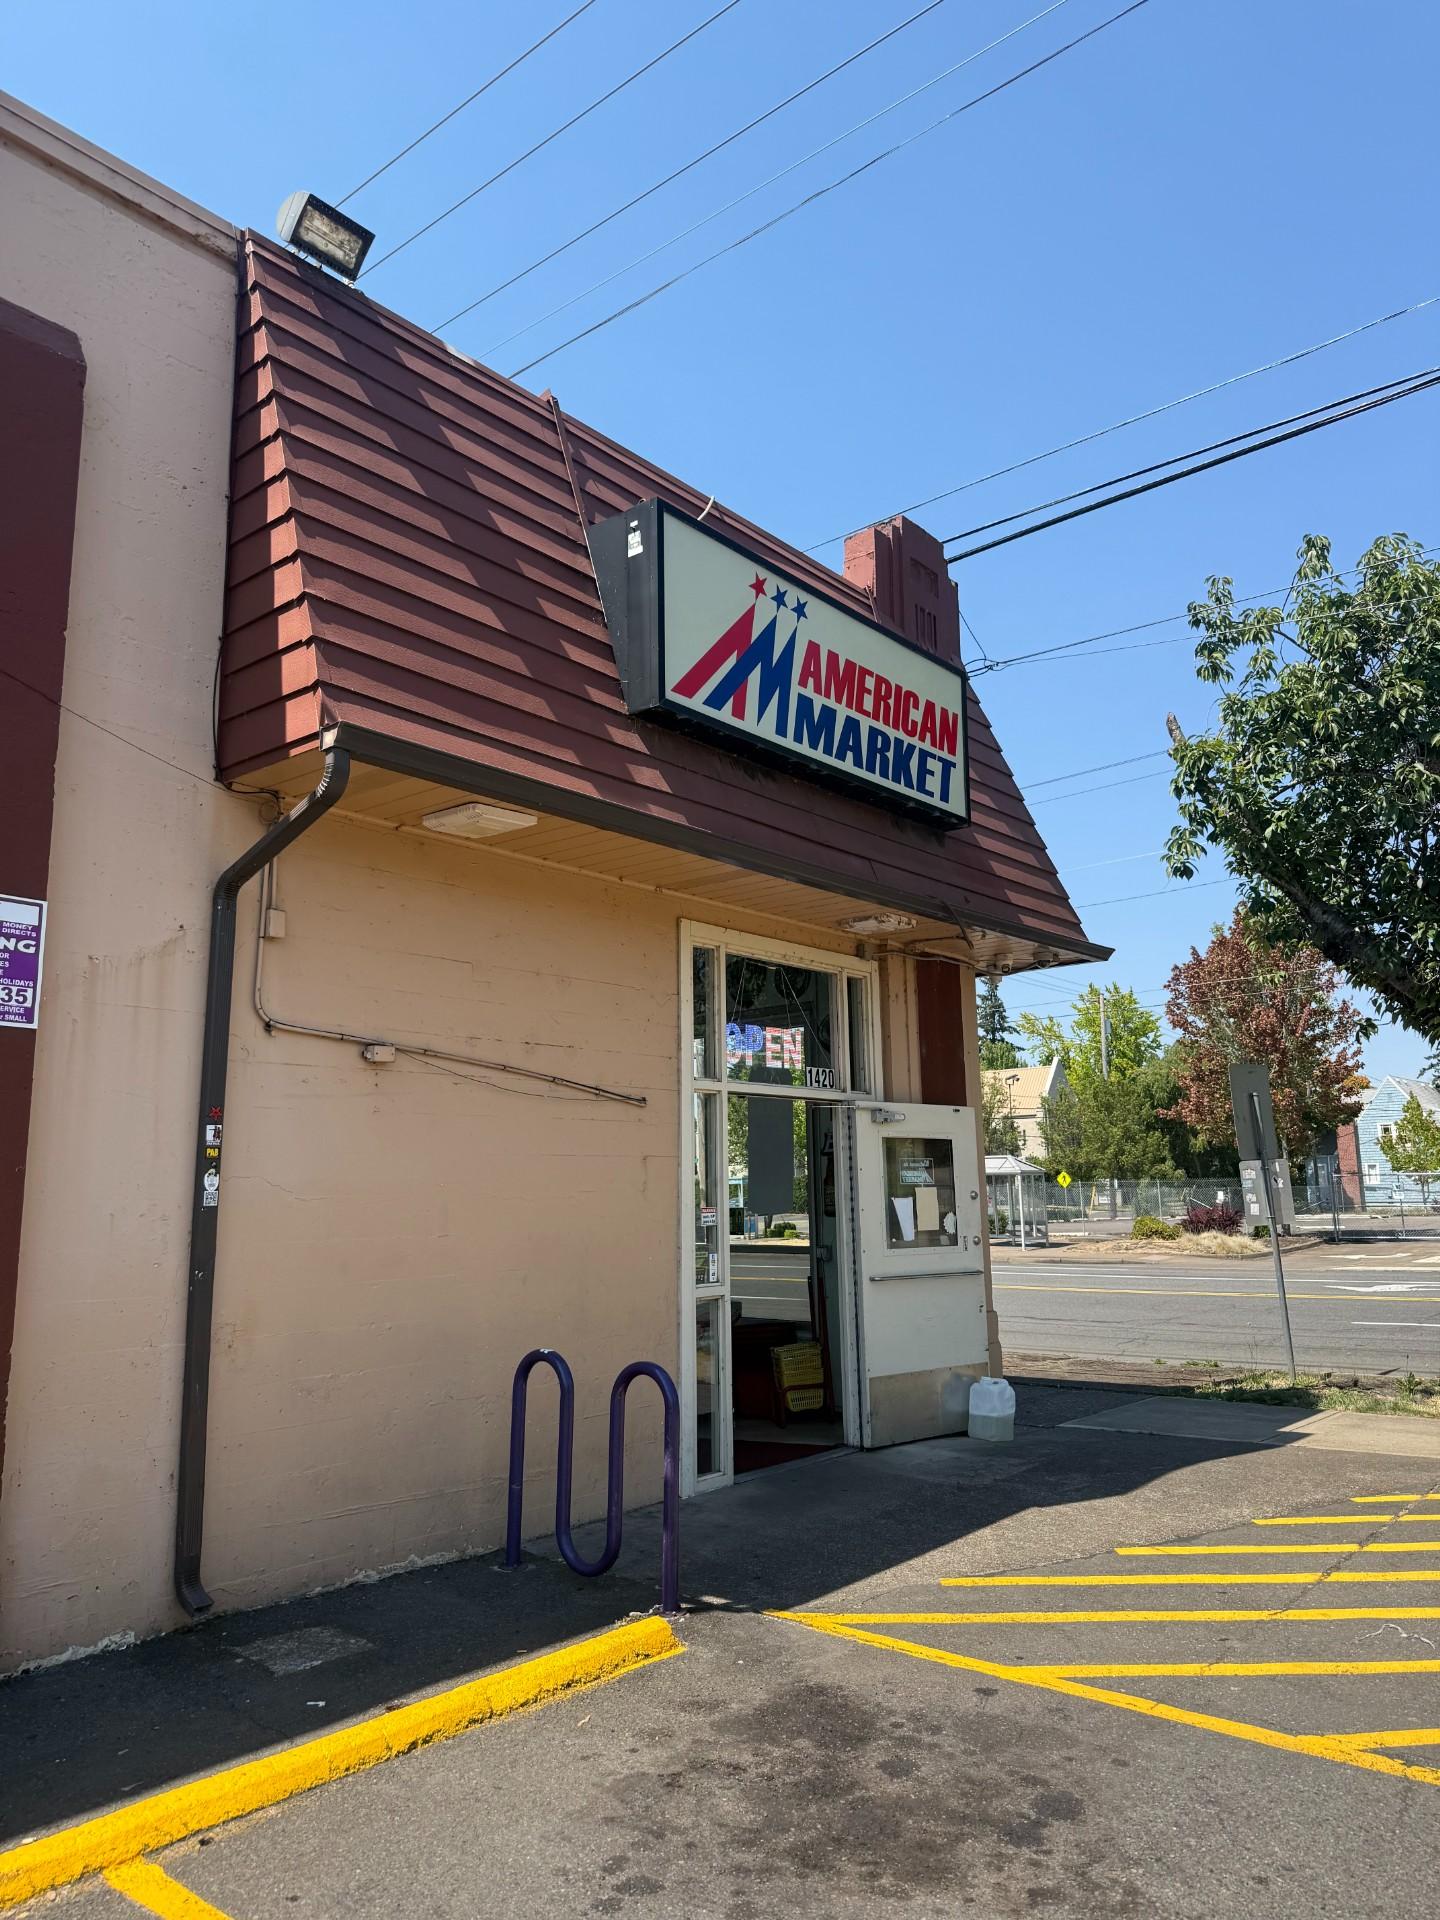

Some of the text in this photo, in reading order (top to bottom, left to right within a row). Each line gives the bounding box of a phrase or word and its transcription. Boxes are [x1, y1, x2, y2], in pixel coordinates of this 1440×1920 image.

[798, 639, 958, 756] AMERICAN
[793, 692, 956, 804] MARKET
[2, 921, 33, 931] MONEY
[2, 927, 37, 936] DIRECTS
[0, 987, 28, 1004] 35
[4, 1014, 27, 1022] SMALL
[726, 1022, 805, 1069] OPEN
[808, 1068, 835, 1088] 1420
